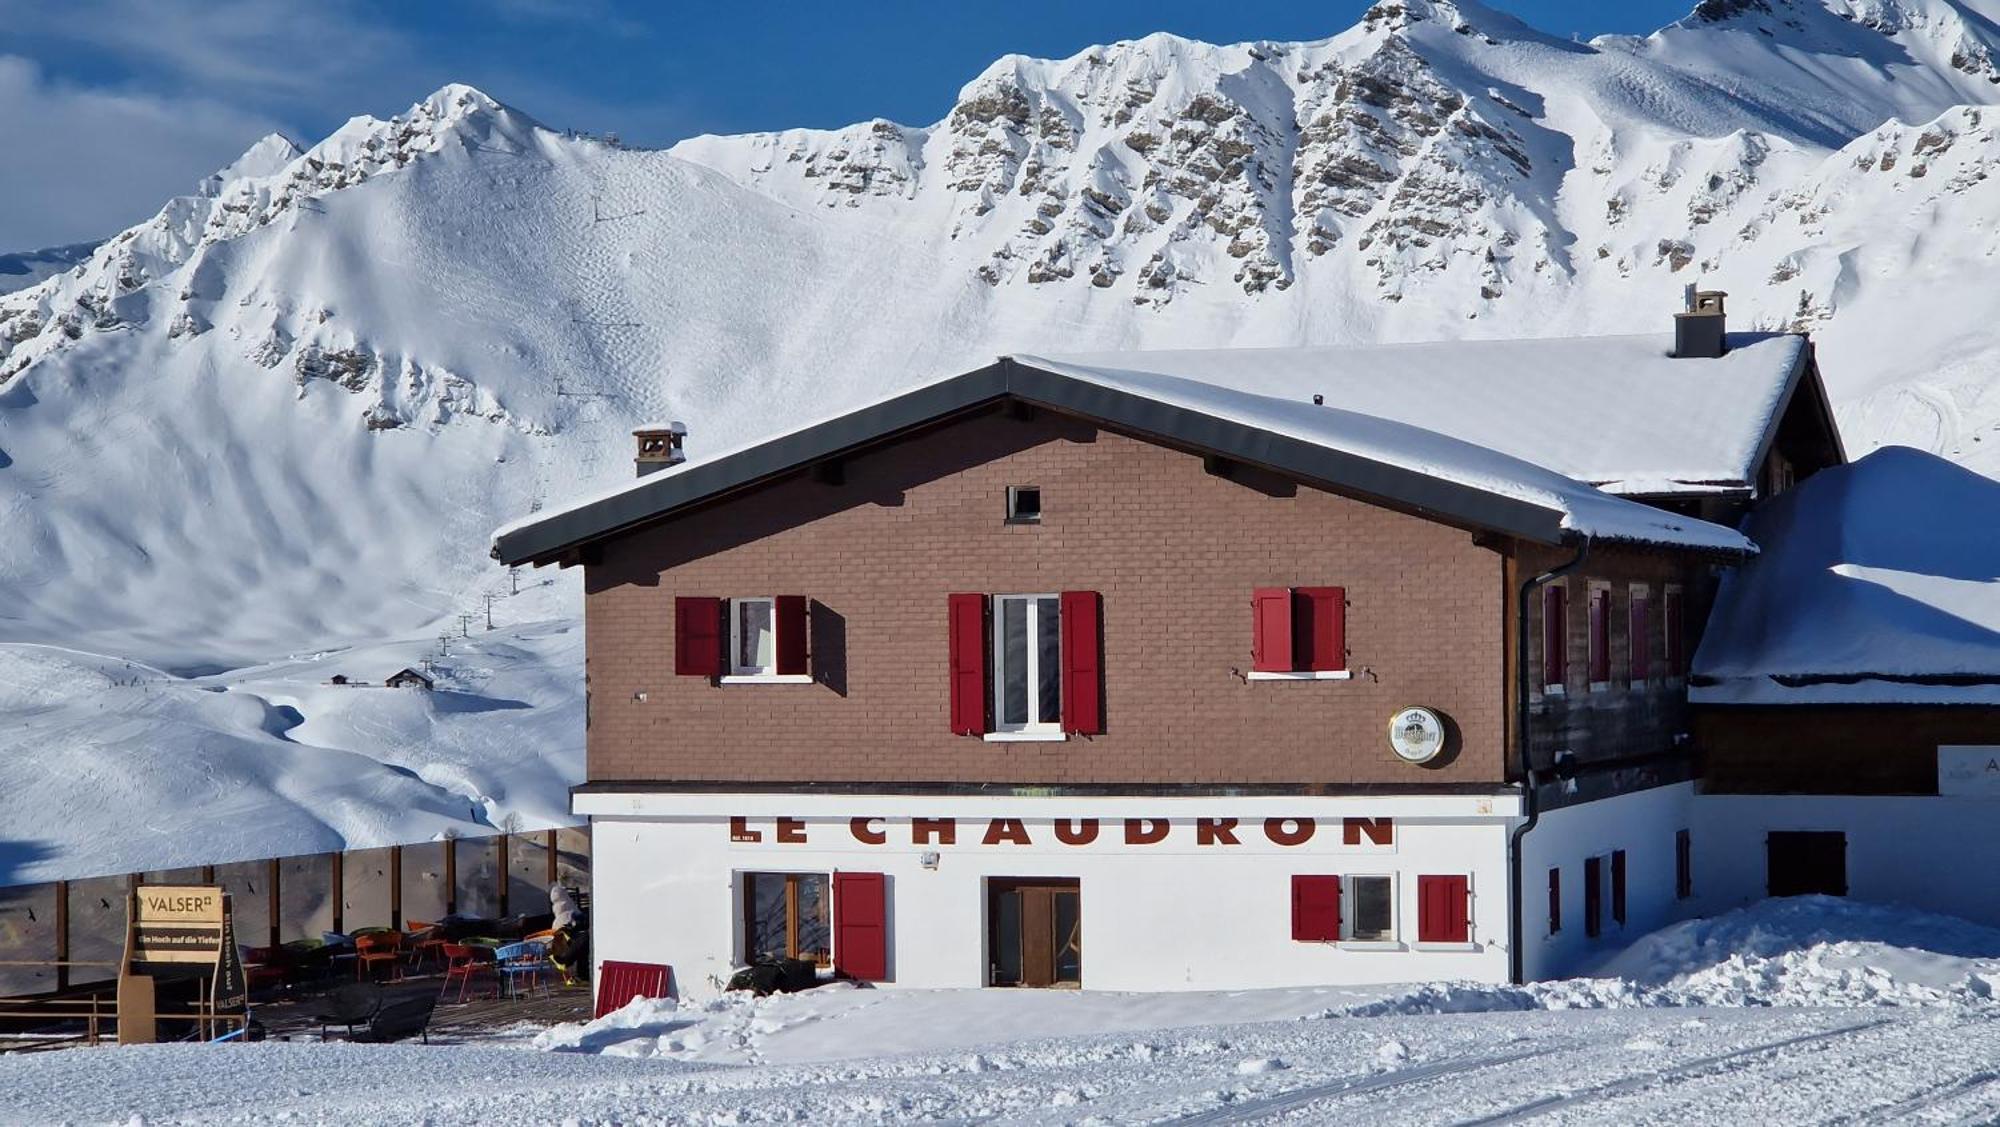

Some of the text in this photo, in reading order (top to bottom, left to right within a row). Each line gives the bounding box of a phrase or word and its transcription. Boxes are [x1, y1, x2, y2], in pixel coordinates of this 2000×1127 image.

[730, 816, 1393, 846] LE CHAUDRON
[148, 897, 204, 912] VALSER
[151, 935, 171, 944] Hoch
[172, 935, 184, 944] auf
[185, 935, 197, 944] die
